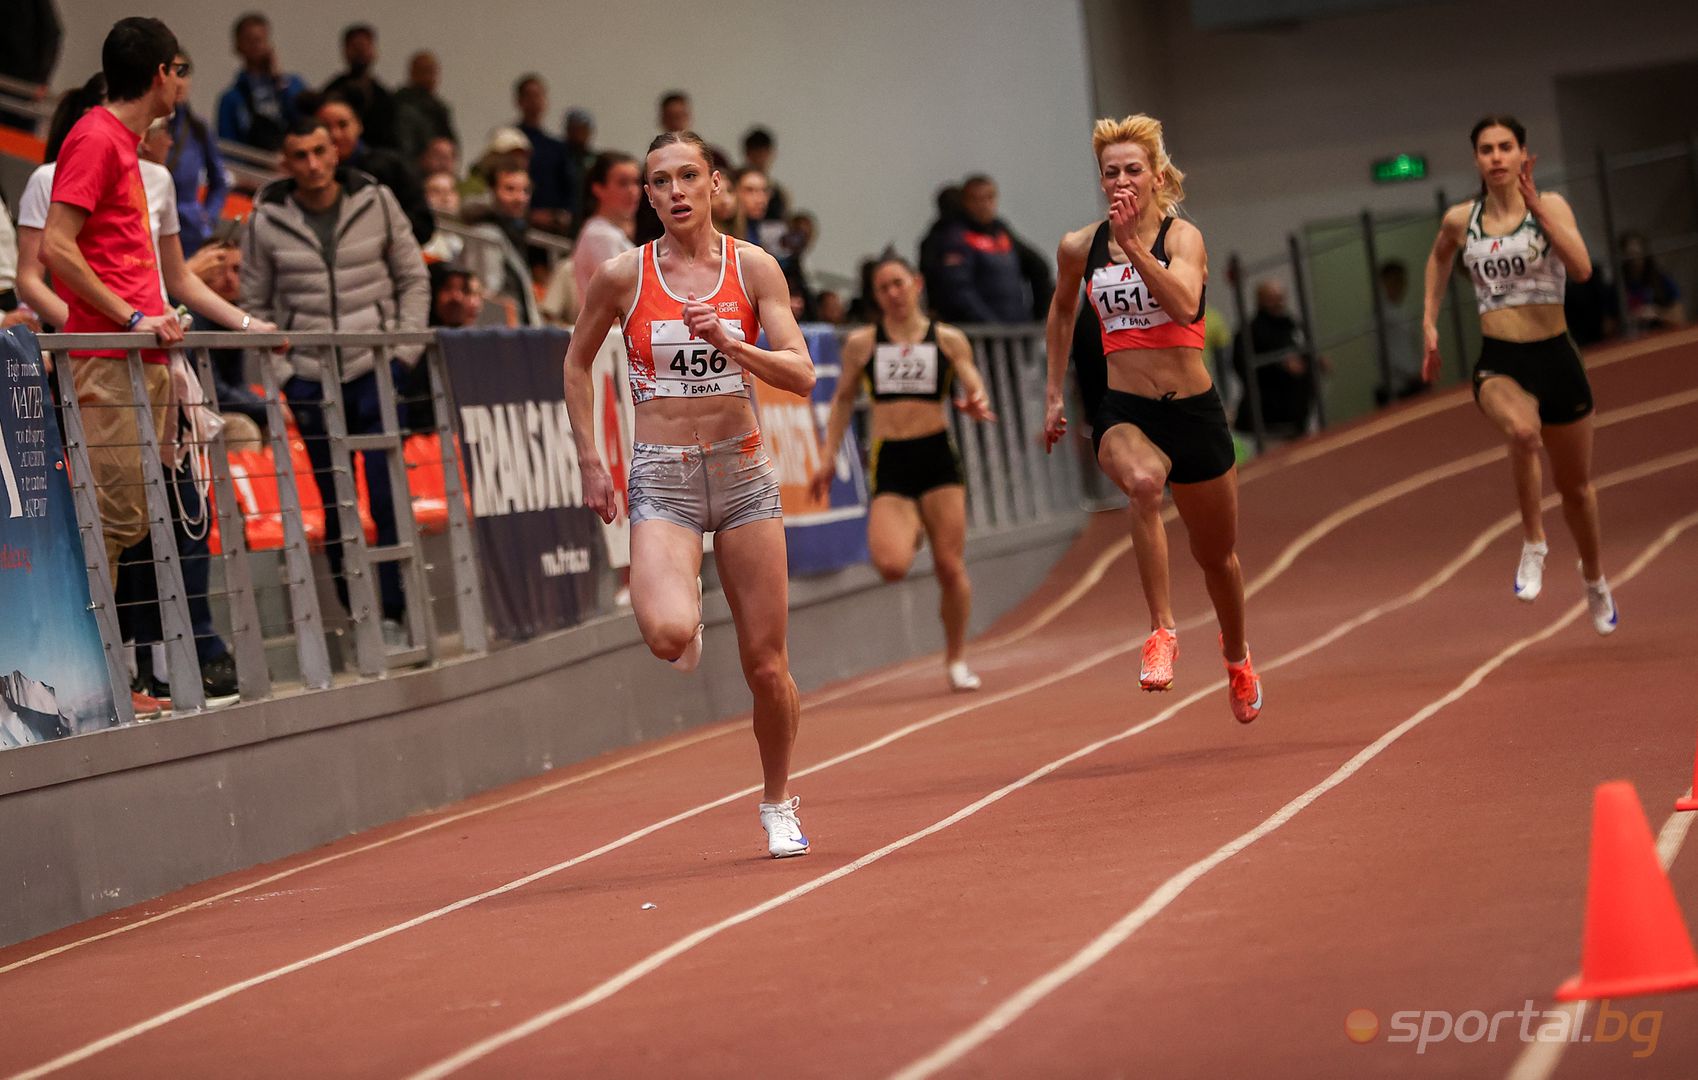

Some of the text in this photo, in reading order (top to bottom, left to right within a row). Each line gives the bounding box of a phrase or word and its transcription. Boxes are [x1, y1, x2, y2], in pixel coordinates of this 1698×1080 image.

[1473, 256, 1525, 283] 1699
[669, 349, 728, 377] 456
[887, 358, 927, 381] 222
[691, 382, 721, 394] БФЛА
